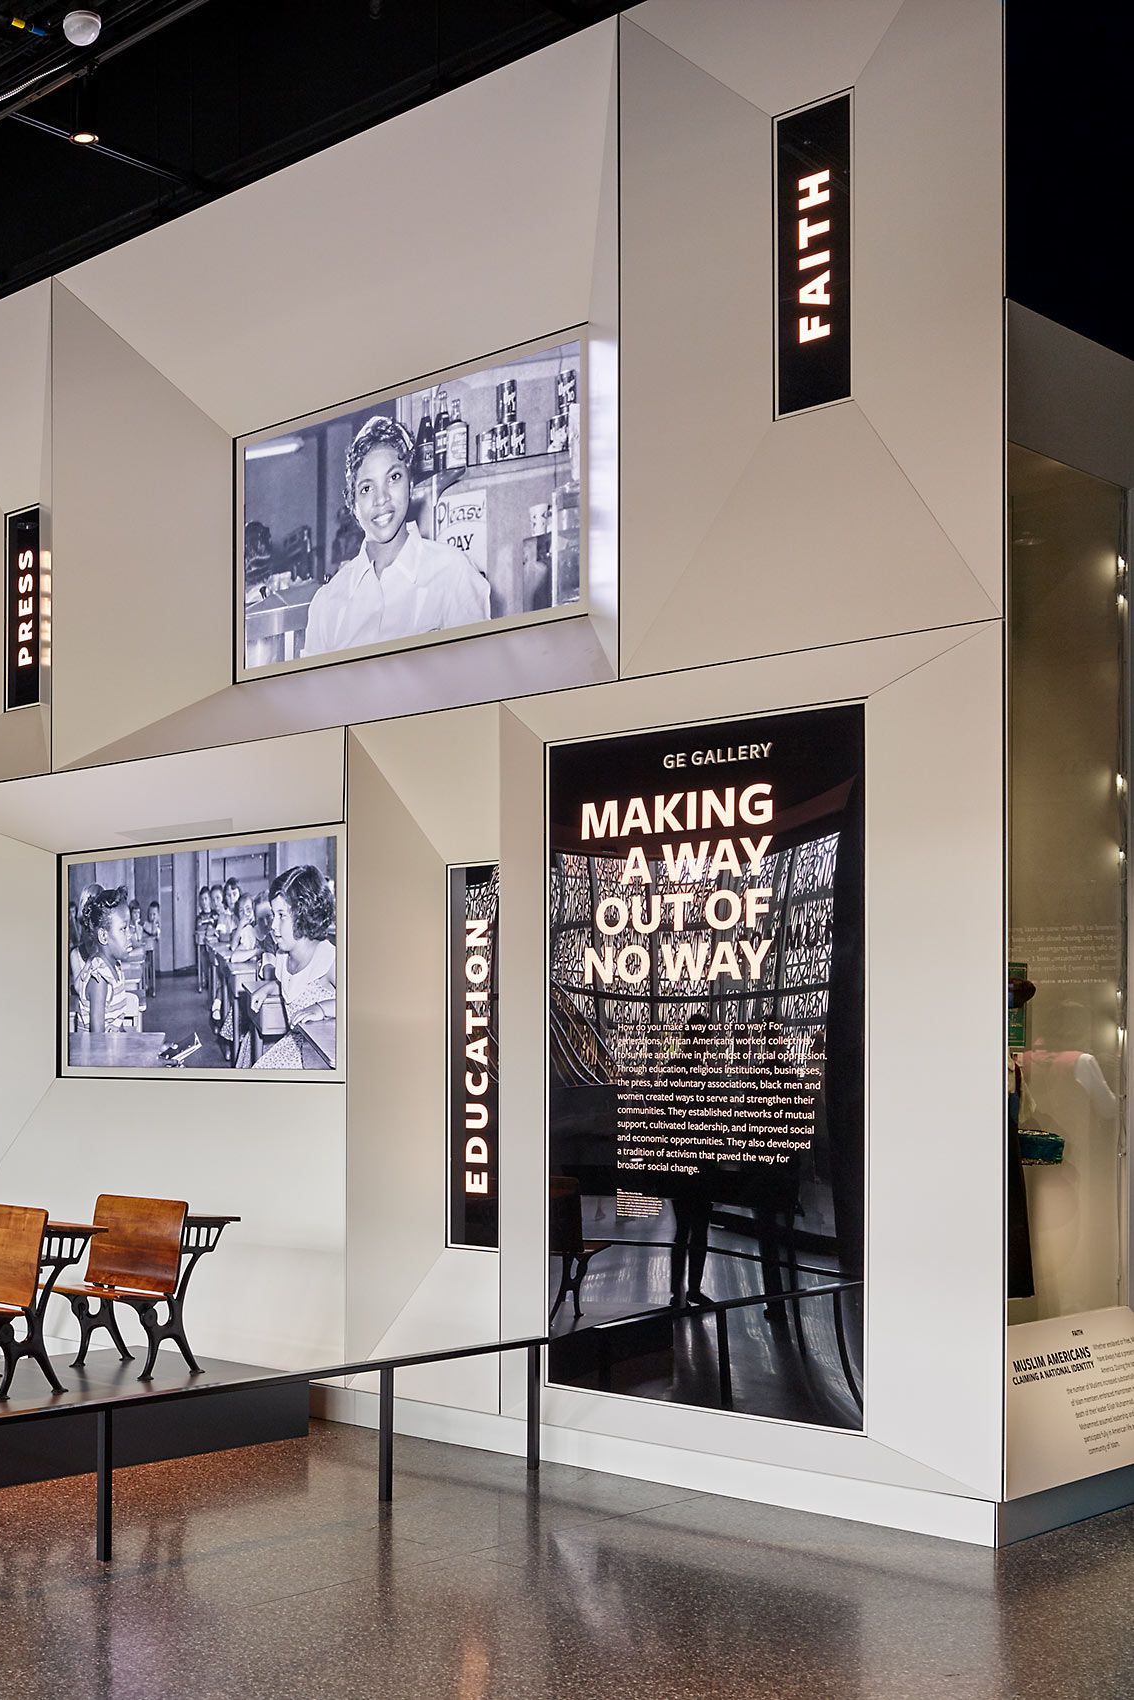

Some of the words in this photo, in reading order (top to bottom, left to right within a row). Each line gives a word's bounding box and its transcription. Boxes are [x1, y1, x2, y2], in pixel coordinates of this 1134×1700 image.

[798, 169, 831, 344] FAITH
[437, 501, 483, 532] Please
[18, 549, 33, 667] PRESS
[663, 753, 687, 769] GE
[691, 742, 773, 766] GALLERY
[581, 782, 774, 840] MAKING
[621, 847, 653, 885] A
[663, 835, 774, 882] WAY
[595, 892, 694, 936] OUT
[705, 888, 772, 930] OF
[584, 946, 651, 984] NO
[662, 939, 772, 982] WAY
[647, 1025, 662, 1033] you
[691, 1025, 706, 1033] way
[724, 1022, 732, 1030] of
[747, 1023, 767, 1032] way?
[618, 1038, 662, 1047] generations,
[693, 1037, 734, 1045] Americans
[736, 1037, 766, 1045] worked
[768, 1036, 815, 1047] collectively
[465, 918, 489, 1195] EDUCATION
[655, 1051, 668, 1059] and
[671, 1051, 692, 1059] thrive
[743, 1051, 752, 1059] of
[754, 1051, 775, 1059] racial
[778, 1052, 827, 1062] oppression.
[617, 1065, 647, 1075] Through
[649, 1065, 688, 1074] education,
[690, 1065, 722, 1075] religious
[725, 1066, 772, 1075] institutions,
[774, 1066, 822, 1076] businesses,
[631, 1080, 652, 1088] press,
[670, 1079, 705, 1090] voluntary
[708, 1080, 758, 1090] associations,
[760, 1080, 782, 1089] black
[804, 1081, 820, 1090] and
[646, 1093, 673, 1101] created
[676, 1095, 694, 1104] ways
[730, 1095, 744, 1103] and
[746, 1095, 792, 1106] strengthen
[794, 1096, 815, 1104] their
[618, 1107, 666, 1115] communities.
[668, 1107, 686, 1118] They
[689, 1108, 732, 1117] established
[734, 1110, 772, 1119] networks
[774, 1110, 783, 1118] of
[785, 1111, 815, 1119] mutual
[618, 1121, 648, 1129] support,
[650, 1121, 686, 1130] cultivated
[688, 1122, 730, 1133] leadership,
[732, 1123, 746, 1132] and
[749, 1124, 788, 1135] improved
[790, 1126, 815, 1134] social
[633, 1135, 668, 1143] economic
[670, 1136, 724, 1146] opportunities.
[727, 1138, 746, 1148] They
[748, 1138, 765, 1147] also
[767, 1139, 810, 1151] developed
[623, 1148, 655, 1157] tradition
[656, 1149, 665, 1157] of
[666, 1150, 697, 1158] activism
[699, 1150, 715, 1159] that
[717, 1151, 740, 1162] paved
[743, 1153, 756, 1161] the
[758, 1154, 775, 1164] way
[777, 1154, 789, 1163] for
[618, 1161, 646, 1170] broader
[648, 1162, 668, 1171] social
[670, 1164, 700, 1175] change.
[1013, 1356, 1046, 1373] MUSLIM
[1047, 1346, 1091, 1366] AMERICANS
[1012, 1372, 1039, 1385] CLAIMING
[1044, 1366, 1071, 1378] NATIONAL
[1071, 1361, 1094, 1372] IDENTITY
